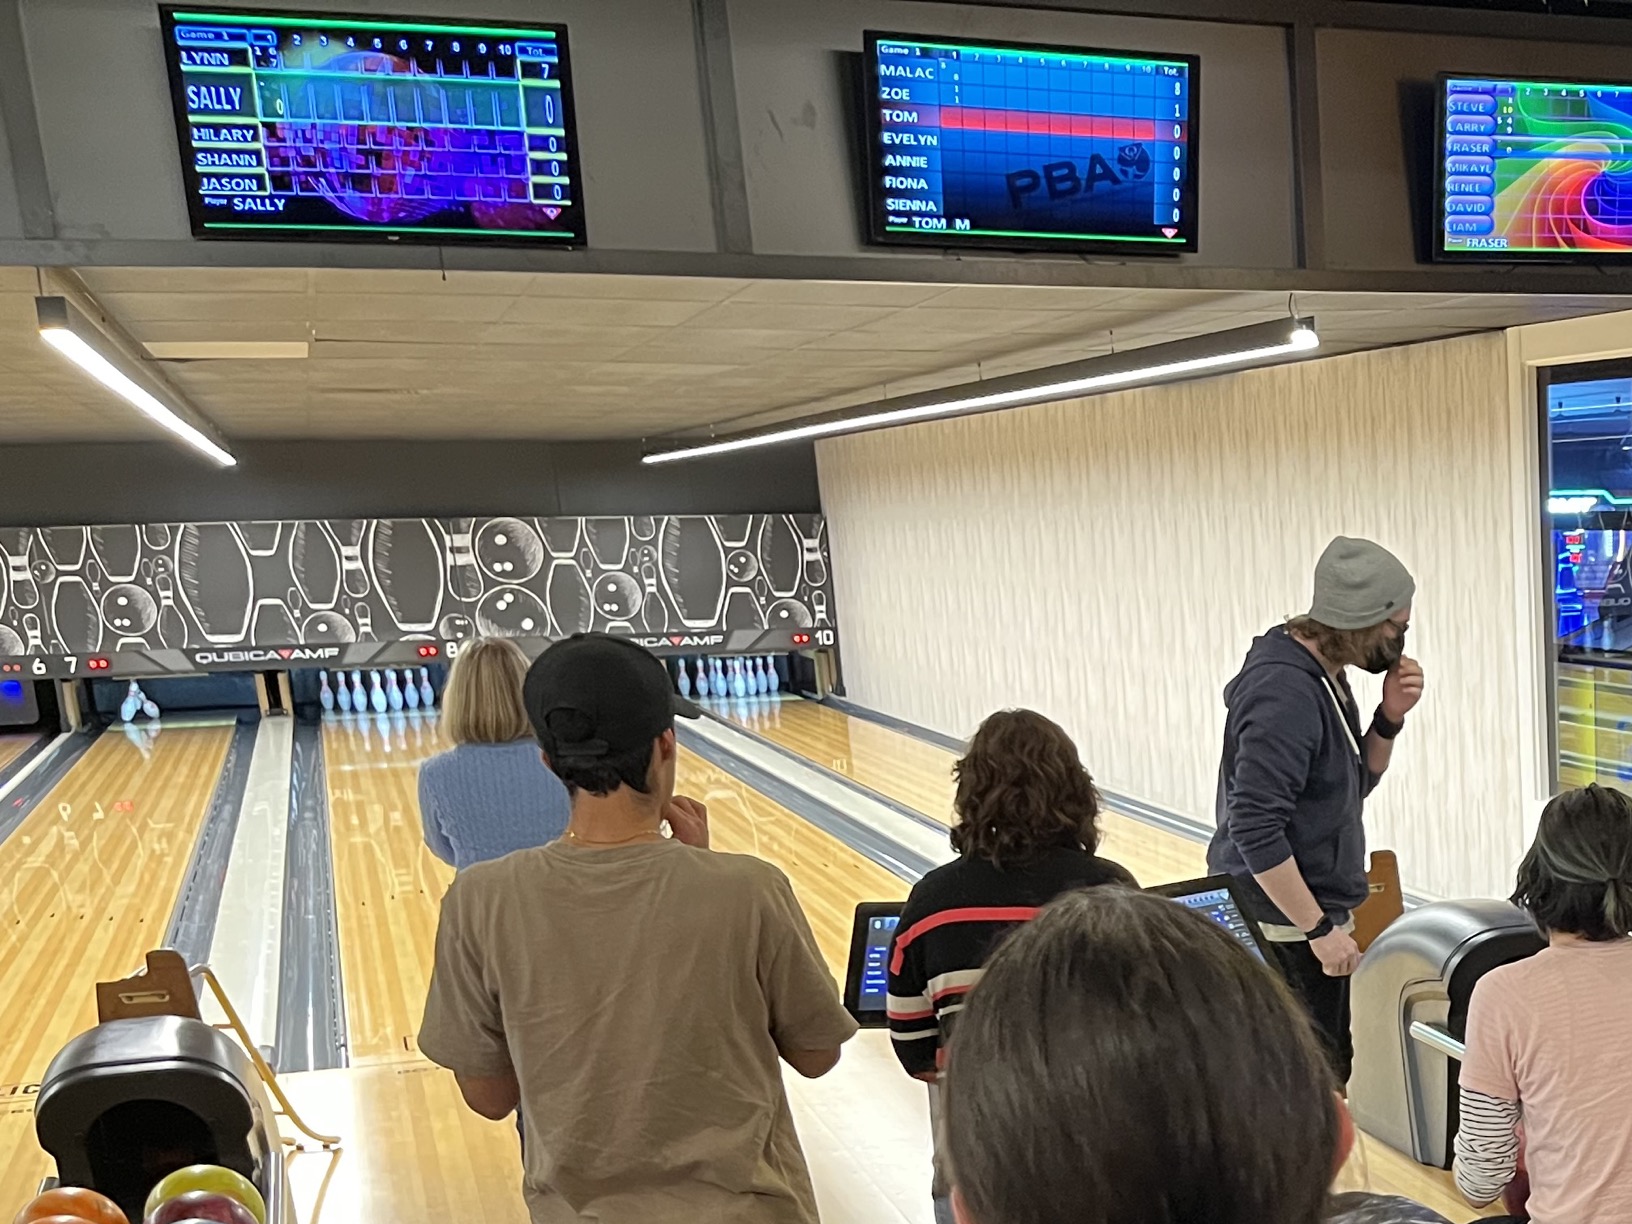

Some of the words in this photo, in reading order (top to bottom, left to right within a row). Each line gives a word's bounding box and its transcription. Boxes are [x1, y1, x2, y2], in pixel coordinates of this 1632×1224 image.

[181, 31, 214, 40] Game
[221, 31, 229, 40] 1
[266, 35, 272, 43] 1
[293, 34, 301, 45] 2
[319, 36, 328, 47] 3
[347, 37, 355, 47] 4
[373, 38, 382, 49] 5
[399, 39, 408, 50] 6
[425, 39, 433, 51] 7
[452, 41, 460, 53] 8
[478, 43, 487, 54] 9
[499, 44, 512, 55] 10
[881, 45, 909, 55] Game
[915, 47, 921, 56] 1
[180, 51, 229, 66] LYNN
[269, 46, 277, 56] 6
[541, 64, 549, 79] 7
[952, 51, 957, 60] 1
[974, 53, 980, 62] 2
[996, 55, 1001, 63] 3
[1018, 56, 1023, 64] 4
[1039, 58, 1045, 66] 5
[1061, 59, 1067, 67] 6
[1083, 60, 1088, 69] 7
[1104, 62, 1109, 71] 8
[1125, 63, 1131, 72] 9
[1142, 65, 1152, 74] 10
[880, 64, 935, 80] MALAC
[1174, 82, 1181, 96] 8
[881, 87, 911, 101] ZOE
[1174, 104, 1181, 118] 1
[1525, 87, 1531, 96] 2
[1543, 87, 1549, 96] 3
[1561, 88, 1567, 97] 4
[1579, 89, 1585, 98] 5
[1597, 90, 1602, 98] 6
[187, 86, 241, 110] SALLY
[276, 99, 284, 115] 0
[545, 95, 554, 124] 0
[1448, 101, 1485, 113] STEVE
[882, 109, 919, 123] TOM
[1173, 124, 1181, 139] 0
[1447, 122, 1486, 132] LARRY
[1506, 116, 1513, 125] 4
[192, 128, 254, 142] HILARY
[549, 136, 557, 152] 0
[882, 131, 938, 146] EVELYN
[1173, 146, 1181, 160] 0
[1447, 143, 1490, 153] FRASER
[197, 152, 257, 167] SHANN
[551, 160, 559, 177] 0
[884, 154, 928, 168] ANNIE
[1173, 167, 1181, 181] 0
[1447, 163, 1492, 174] MIKAYL
[201, 177, 257, 191] JASON
[553, 185, 562, 200] 0
[884, 175, 929, 190] FIONA
[1172, 187, 1180, 202] 0
[1006, 154, 1122, 209] PBA
[1447, 183, 1481, 193] RENEE
[233, 198, 286, 211] SALLY
[885, 197, 937, 212] SIENNA
[1172, 208, 1180, 223] 0
[1447, 203, 1485, 213] DAVID
[912, 216, 947, 230] TOM
[955, 218, 971, 231] M
[1446, 223, 1477, 232] LIAM
[1466, 238, 1508, 248] FRASER
[814, 629, 835, 646] 10
[31, 656, 47, 675] 6
[63, 656, 78, 674] 7
